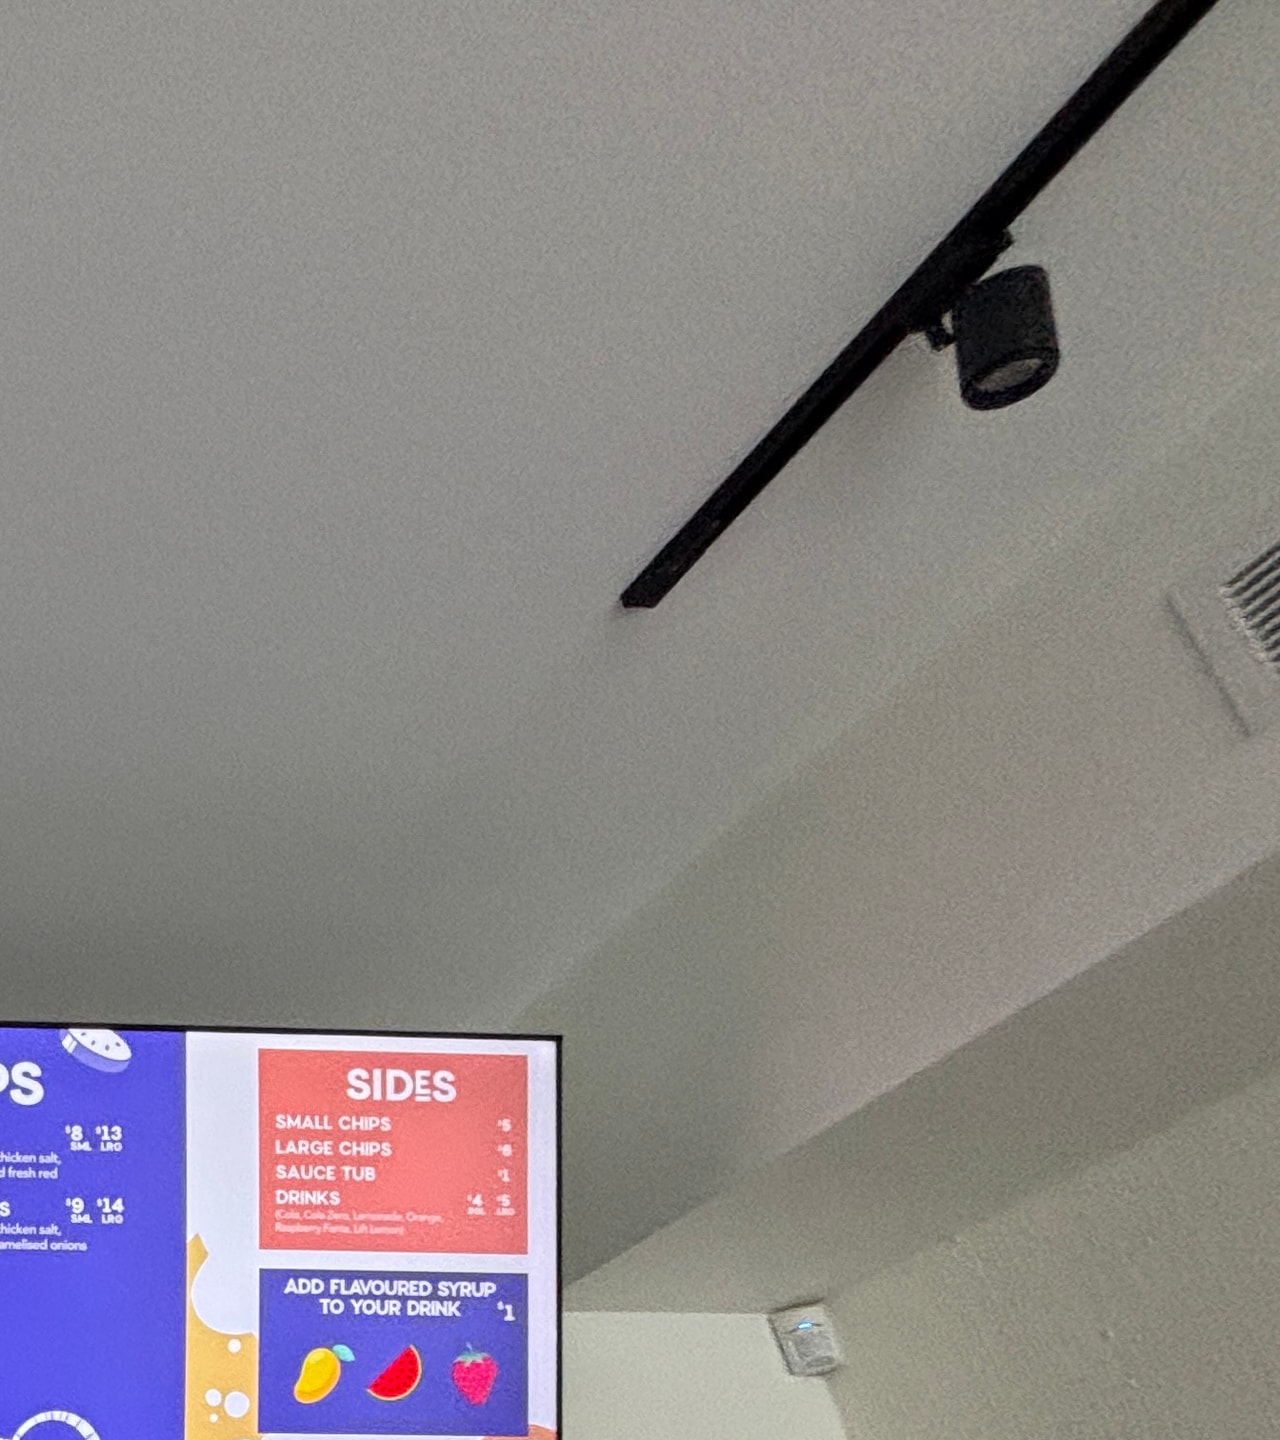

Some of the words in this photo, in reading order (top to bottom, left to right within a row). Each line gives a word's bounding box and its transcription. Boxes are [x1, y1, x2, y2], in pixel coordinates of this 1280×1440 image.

[346, 1068, 456, 1102] SIDES
[275, 1114, 332, 1130] SMALL
[338, 1115, 391, 1131] CHIPS
[65, 1125, 83, 1141] $8
[96, 1125, 122, 1141] $13
[274, 1139, 333, 1155] LARGE
[338, 1141, 392, 1156] CHIPS
[275, 1164, 336, 1180] SAUCE
[342, 1165, 376, 1181] TUB
[66, 1197, 85, 1214] $9
[97, 1197, 124, 1214] $14
[275, 1189, 340, 1205] DRINKS
[283, 1278, 325, 1295] ADD
[329, 1279, 433, 1297] FLAVOURED
[437, 1281, 496, 1297] SYRUP
[318, 1298, 344, 1314] TO
[350, 1299, 401, 1315] YOUR
[406, 1300, 461, 1316] DRINK
[496, 1301, 515, 1321] $1
